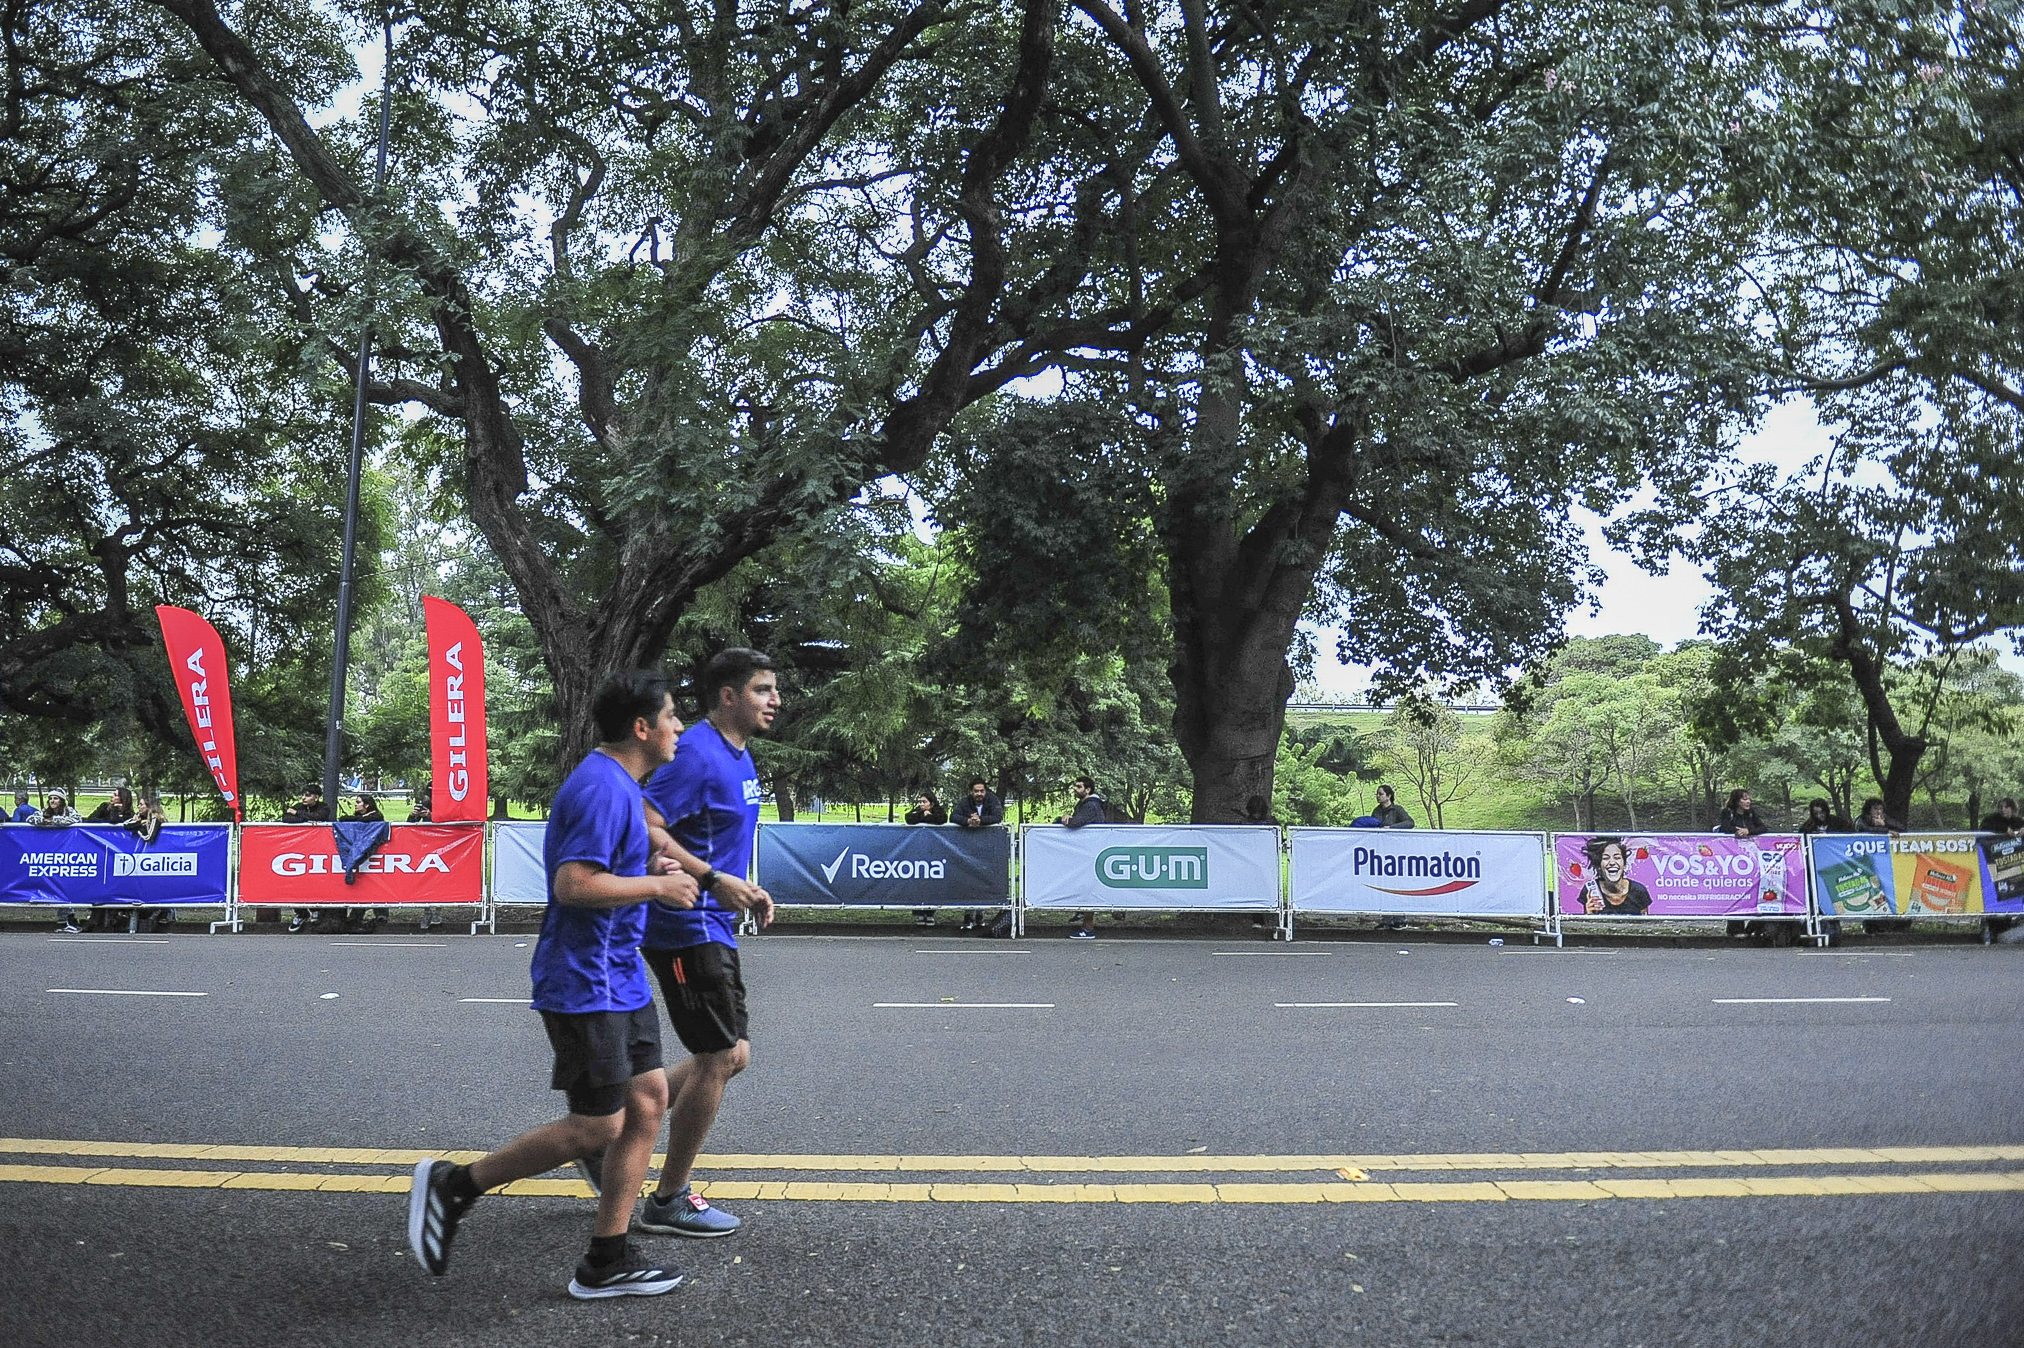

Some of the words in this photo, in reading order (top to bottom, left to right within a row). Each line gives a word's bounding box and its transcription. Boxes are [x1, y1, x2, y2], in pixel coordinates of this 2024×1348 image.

[446, 641, 469, 801] GILERA
[1844, 840, 1886, 857] ¿QUE
[1890, 839, 1934, 853] TEAM
[1936, 839, 1977, 853] SOS?
[19, 853, 98, 865] AMERICAN
[140, 856, 192, 872] Galicia
[852, 853, 946, 879] Rexona
[1353, 846, 1481, 878] Pharmaton
[1650, 854, 1755, 876] VOS&YO
[28, 866, 98, 877] EXPRESS
[1655, 876, 1699, 888] donde
[1703, 876, 1753, 889] quieras
[1657, 893, 1668, 901] NO
[1669, 893, 1697, 901] necesita
